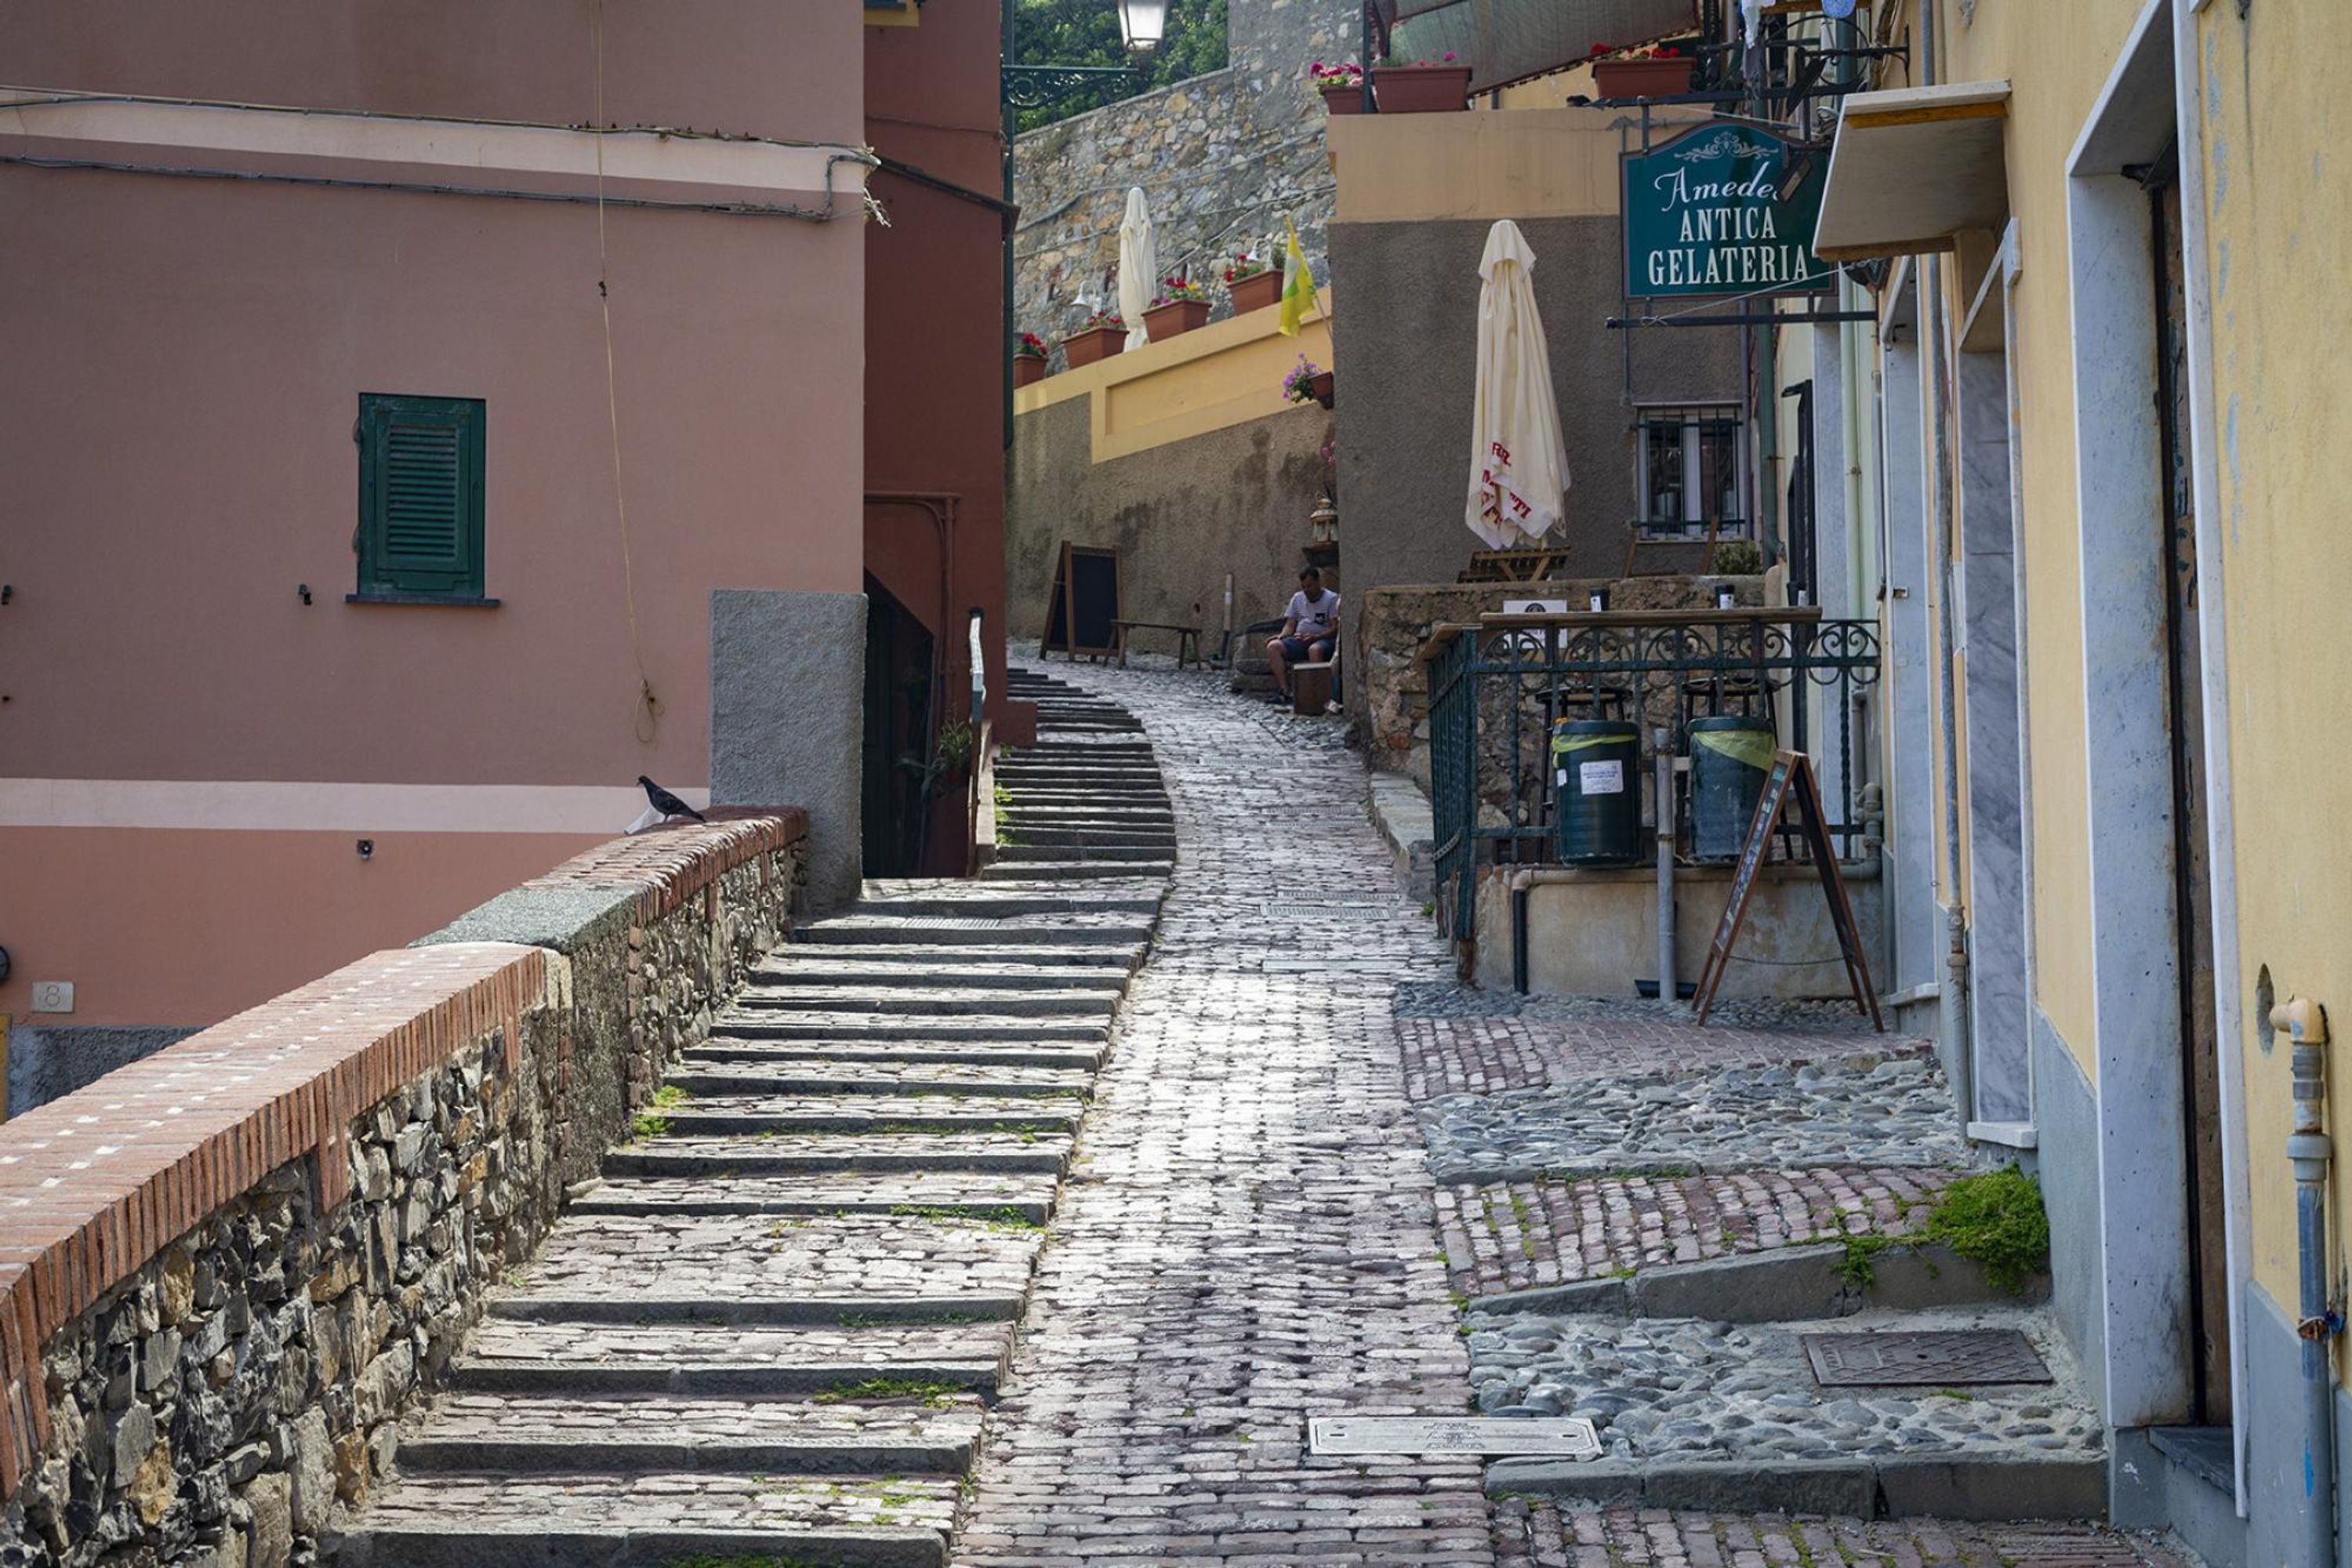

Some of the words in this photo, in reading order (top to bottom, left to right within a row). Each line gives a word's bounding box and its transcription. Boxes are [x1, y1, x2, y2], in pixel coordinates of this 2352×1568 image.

[1653, 161, 1779, 212] Amede
[1679, 205, 1777, 242] ANTICA
[1647, 244, 1809, 286] GELATERIA
[45, 984, 61, 1007] 8
